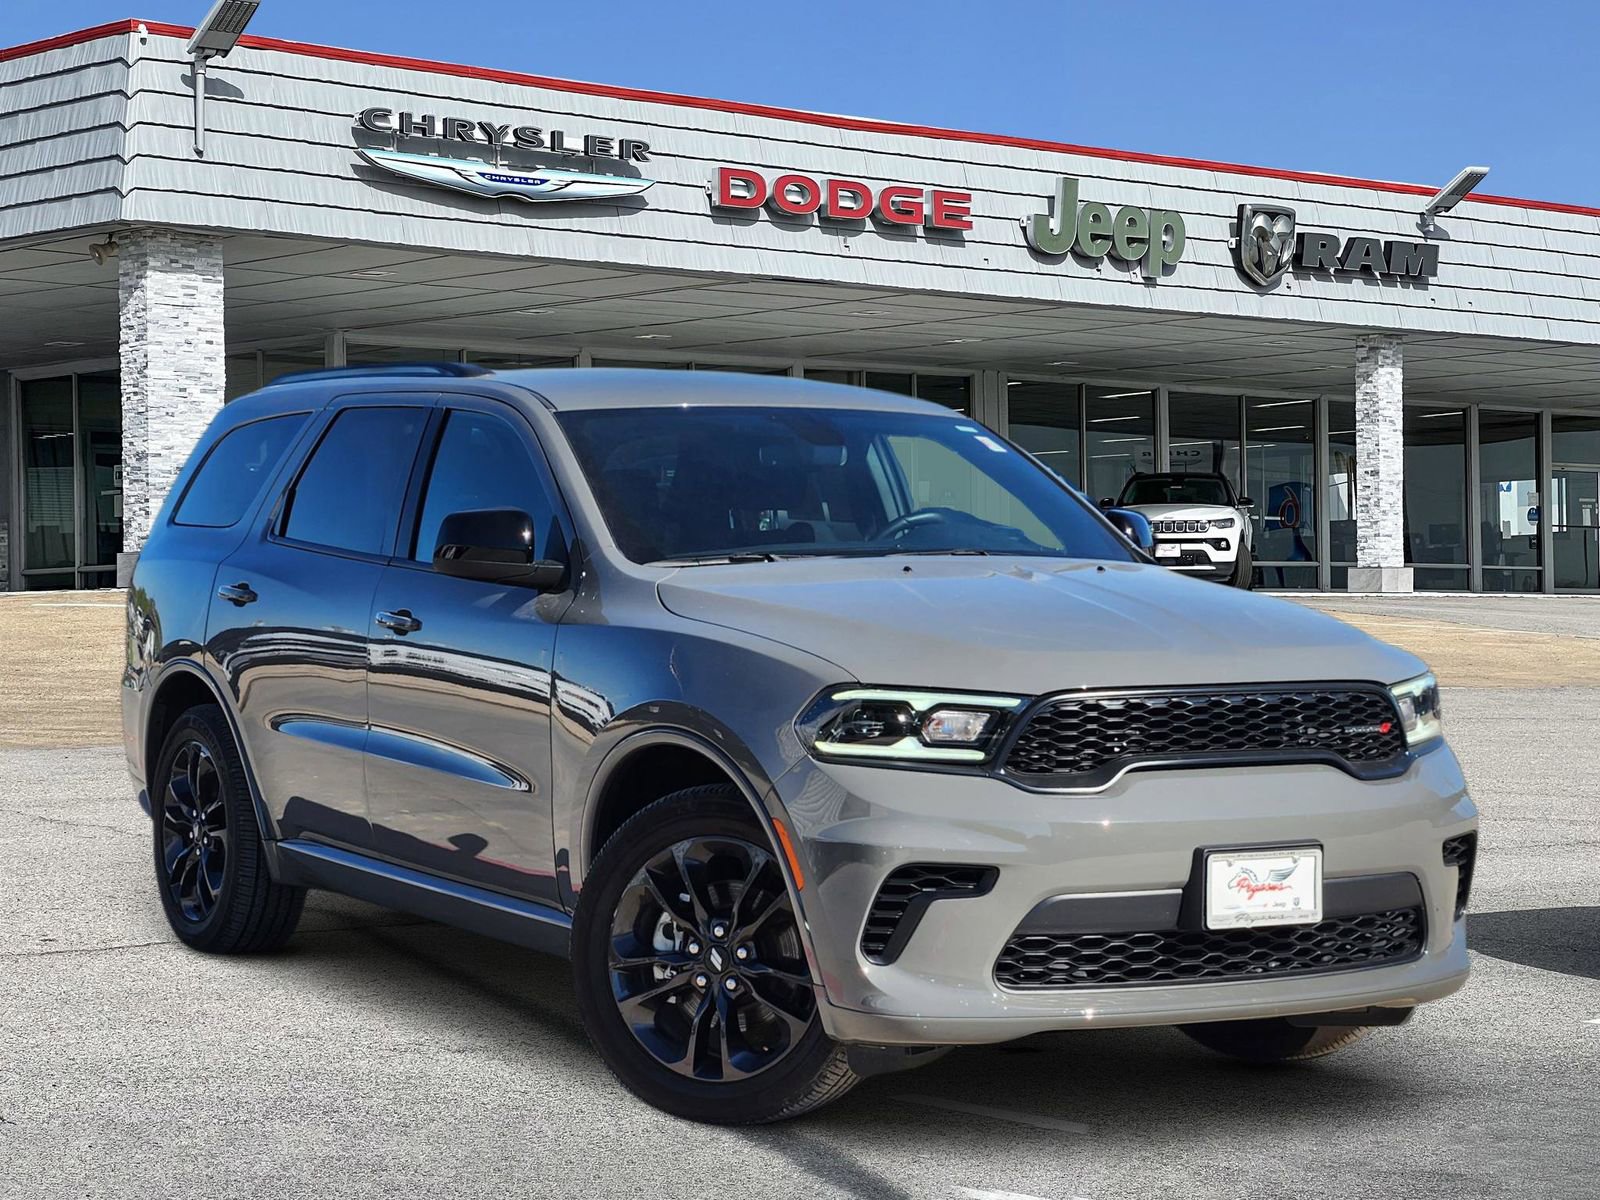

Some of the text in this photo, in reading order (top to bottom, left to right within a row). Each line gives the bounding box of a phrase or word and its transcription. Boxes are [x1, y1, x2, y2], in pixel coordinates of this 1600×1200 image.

[355, 107, 650, 162] CHRYSLER
[484, 174, 541, 184] CHRYSLER
[711, 167, 973, 230] DODGE
[1028, 177, 1186, 278] Jeep
[1300, 232, 1440, 277] RAM
